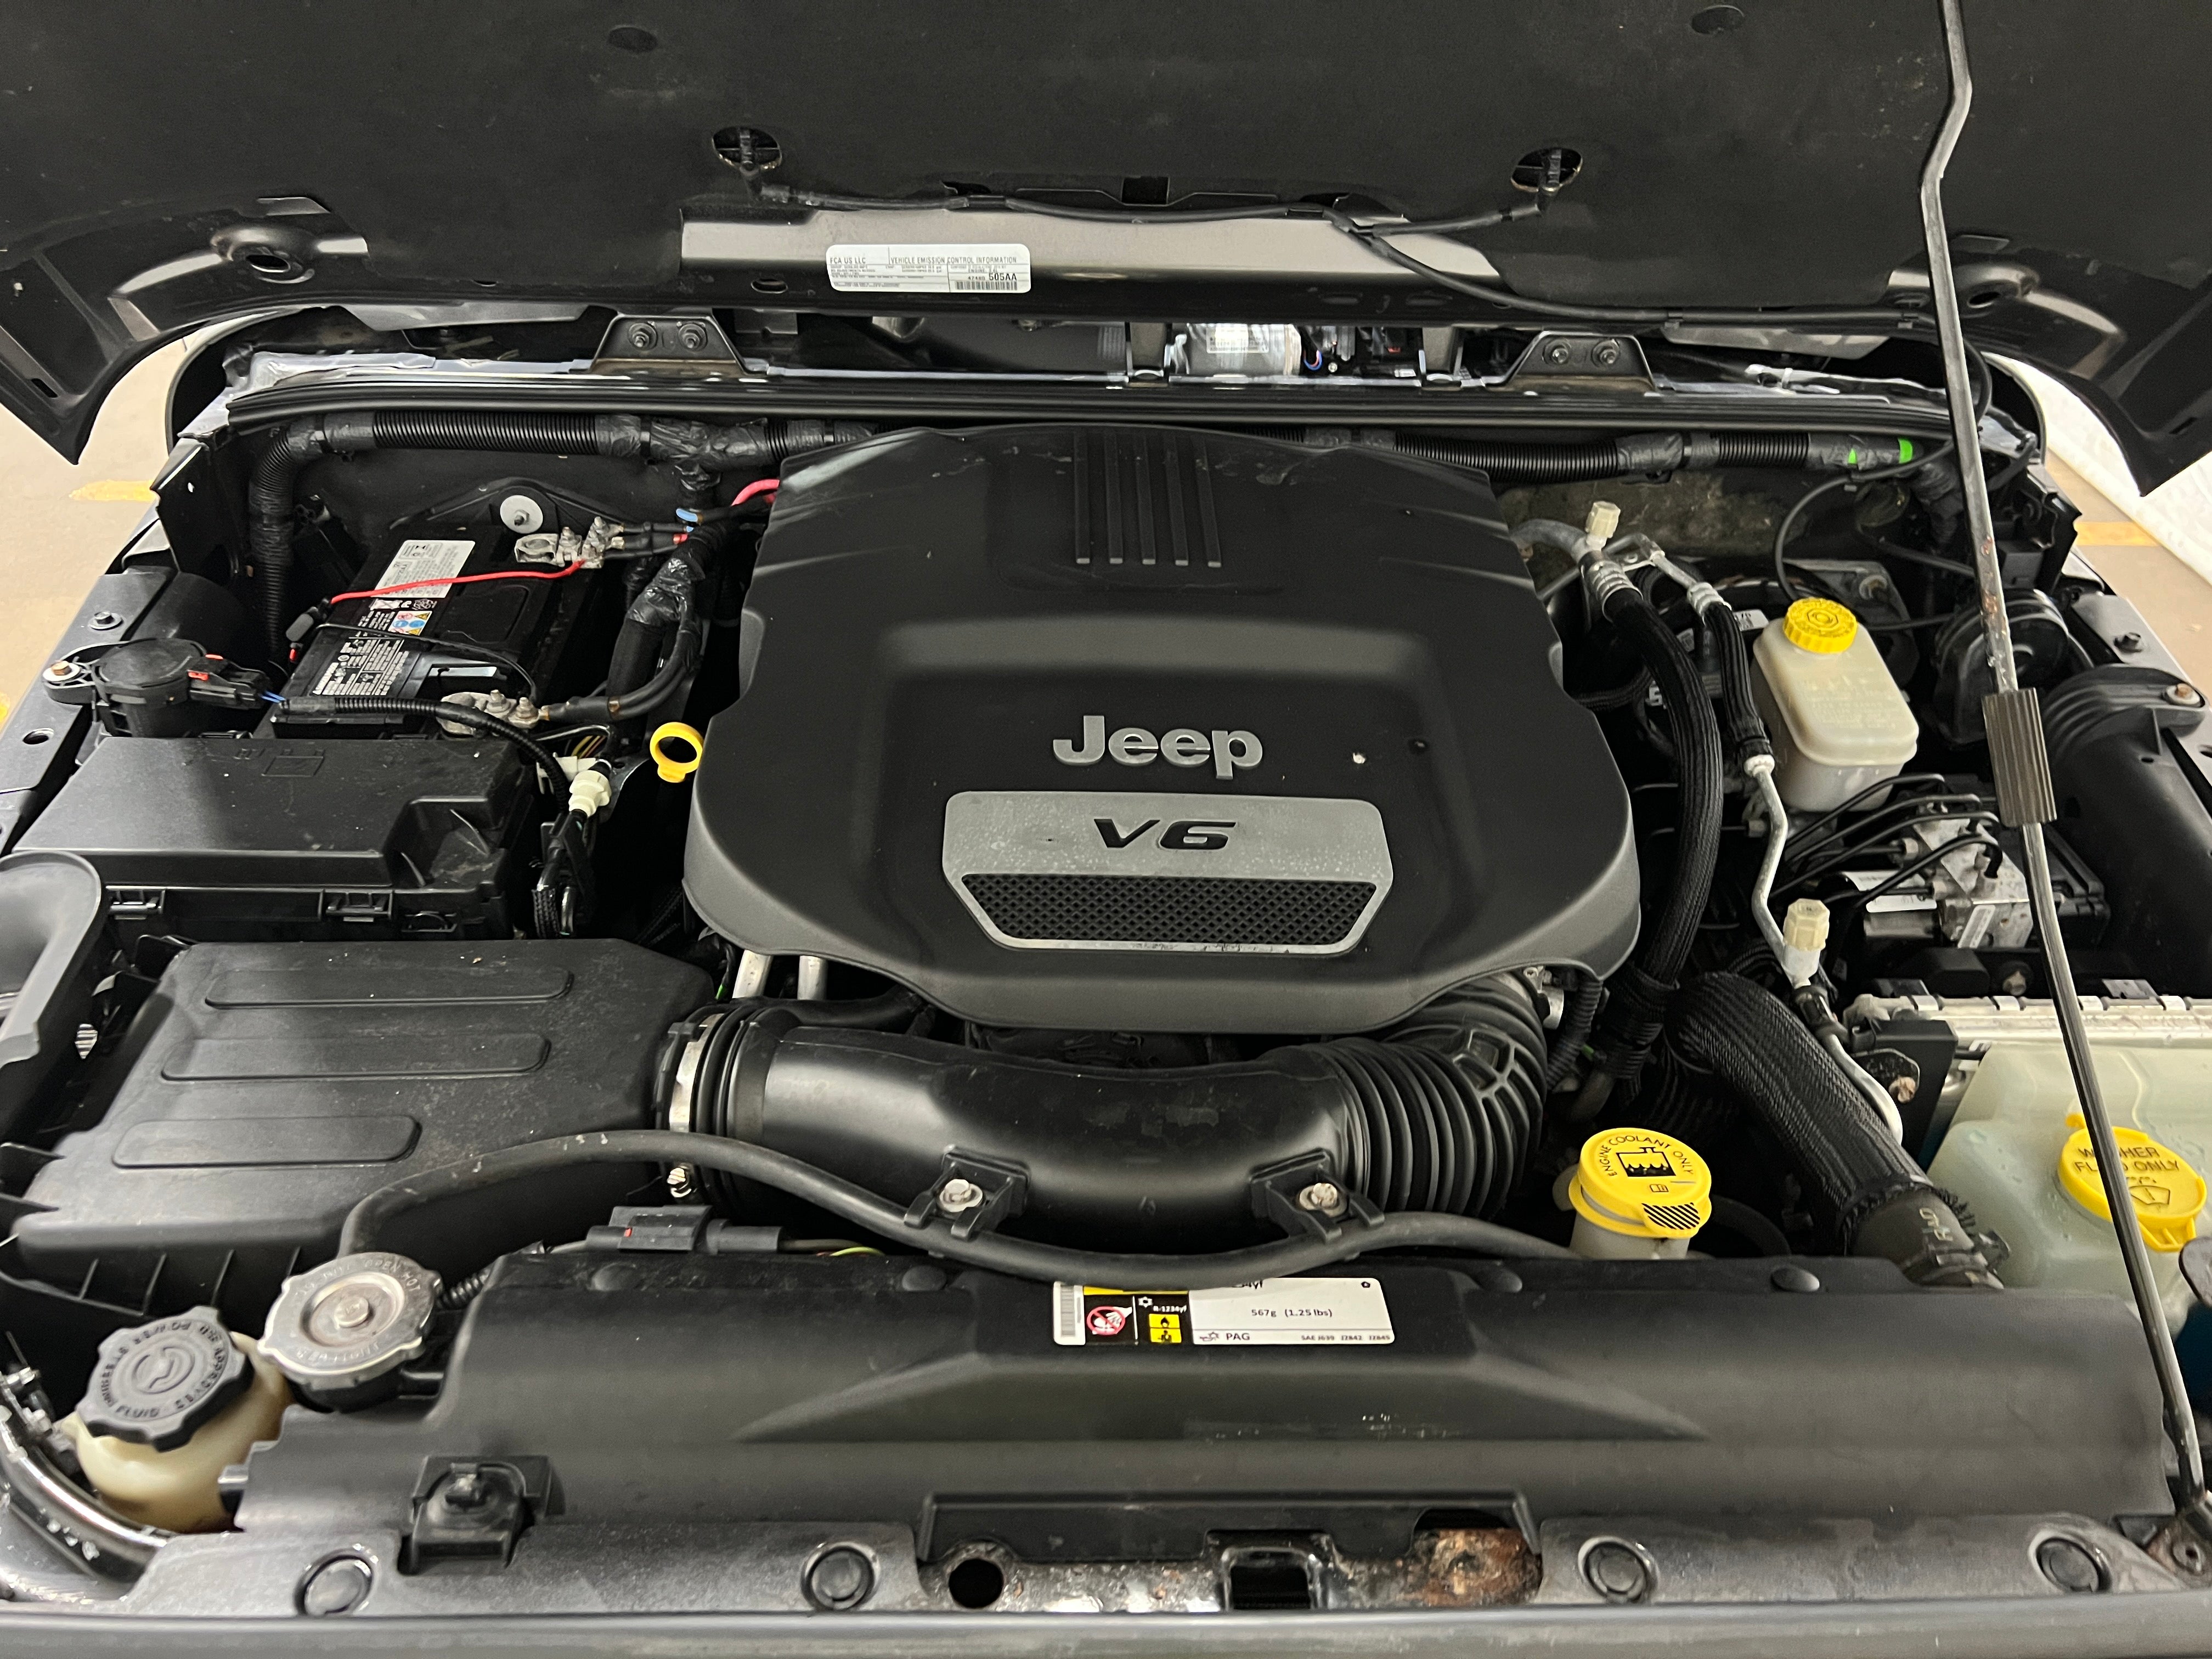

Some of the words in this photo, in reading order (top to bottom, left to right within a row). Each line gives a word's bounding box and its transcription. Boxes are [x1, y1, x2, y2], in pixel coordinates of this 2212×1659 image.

[988, 272, 1017, 281] 505AA
[1052, 715, 1264, 780] Jeep
[1093, 818, 1237, 850] V6
[1608, 1135, 1672, 1149] COOLANT
[2078, 1147, 2160, 1158] WHER
[1599, 1144, 1618, 1177] ENGINE
[1672, 1150, 1694, 1175] ONLY
[2134, 1160, 2180, 1172] ONLY
[1251, 1309, 1277, 1318] 567g
[1284, 1309, 1312, 1318] (1.25
[1313, 1309, 1333, 1318] lbs)
[1226, 1333, 1250, 1341] PAG
[115, 1404, 161, 1419] FLUID
